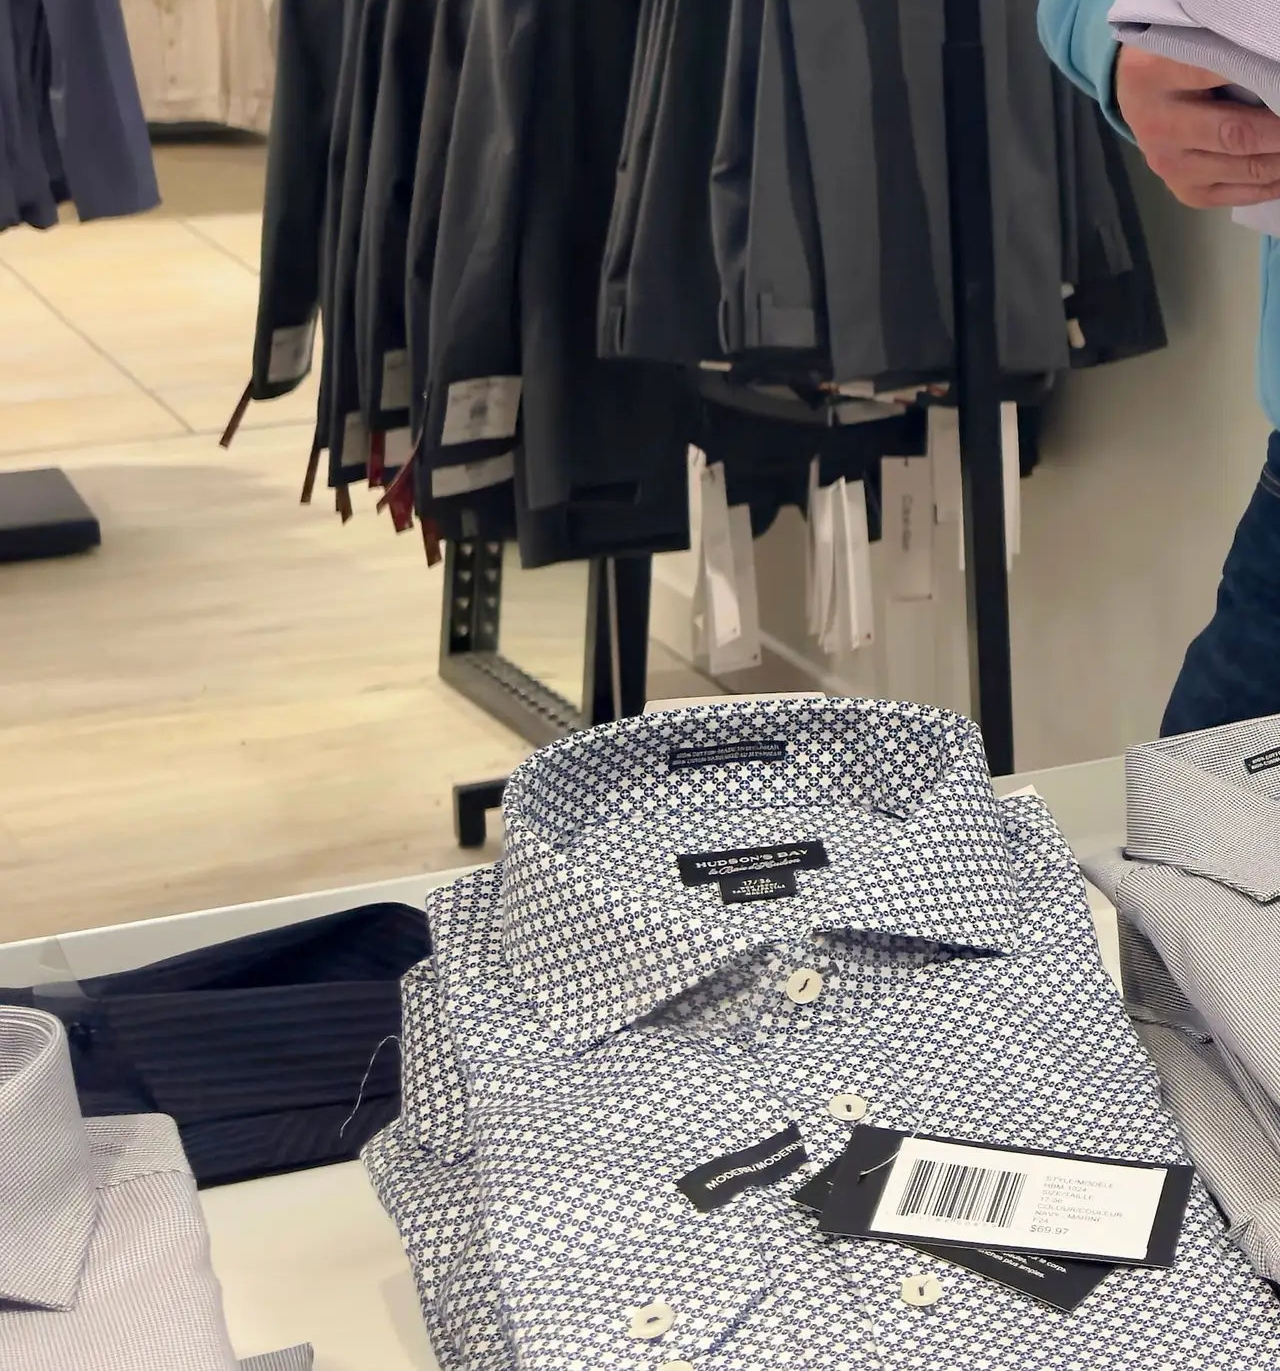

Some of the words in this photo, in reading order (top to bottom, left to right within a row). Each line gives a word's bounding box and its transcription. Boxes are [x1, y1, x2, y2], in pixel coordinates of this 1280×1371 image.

[695, 853, 774, 869] HUDSON'S
[776, 848, 809, 859] BAY
[1029, 1224, 1070, 1236] $69.97
